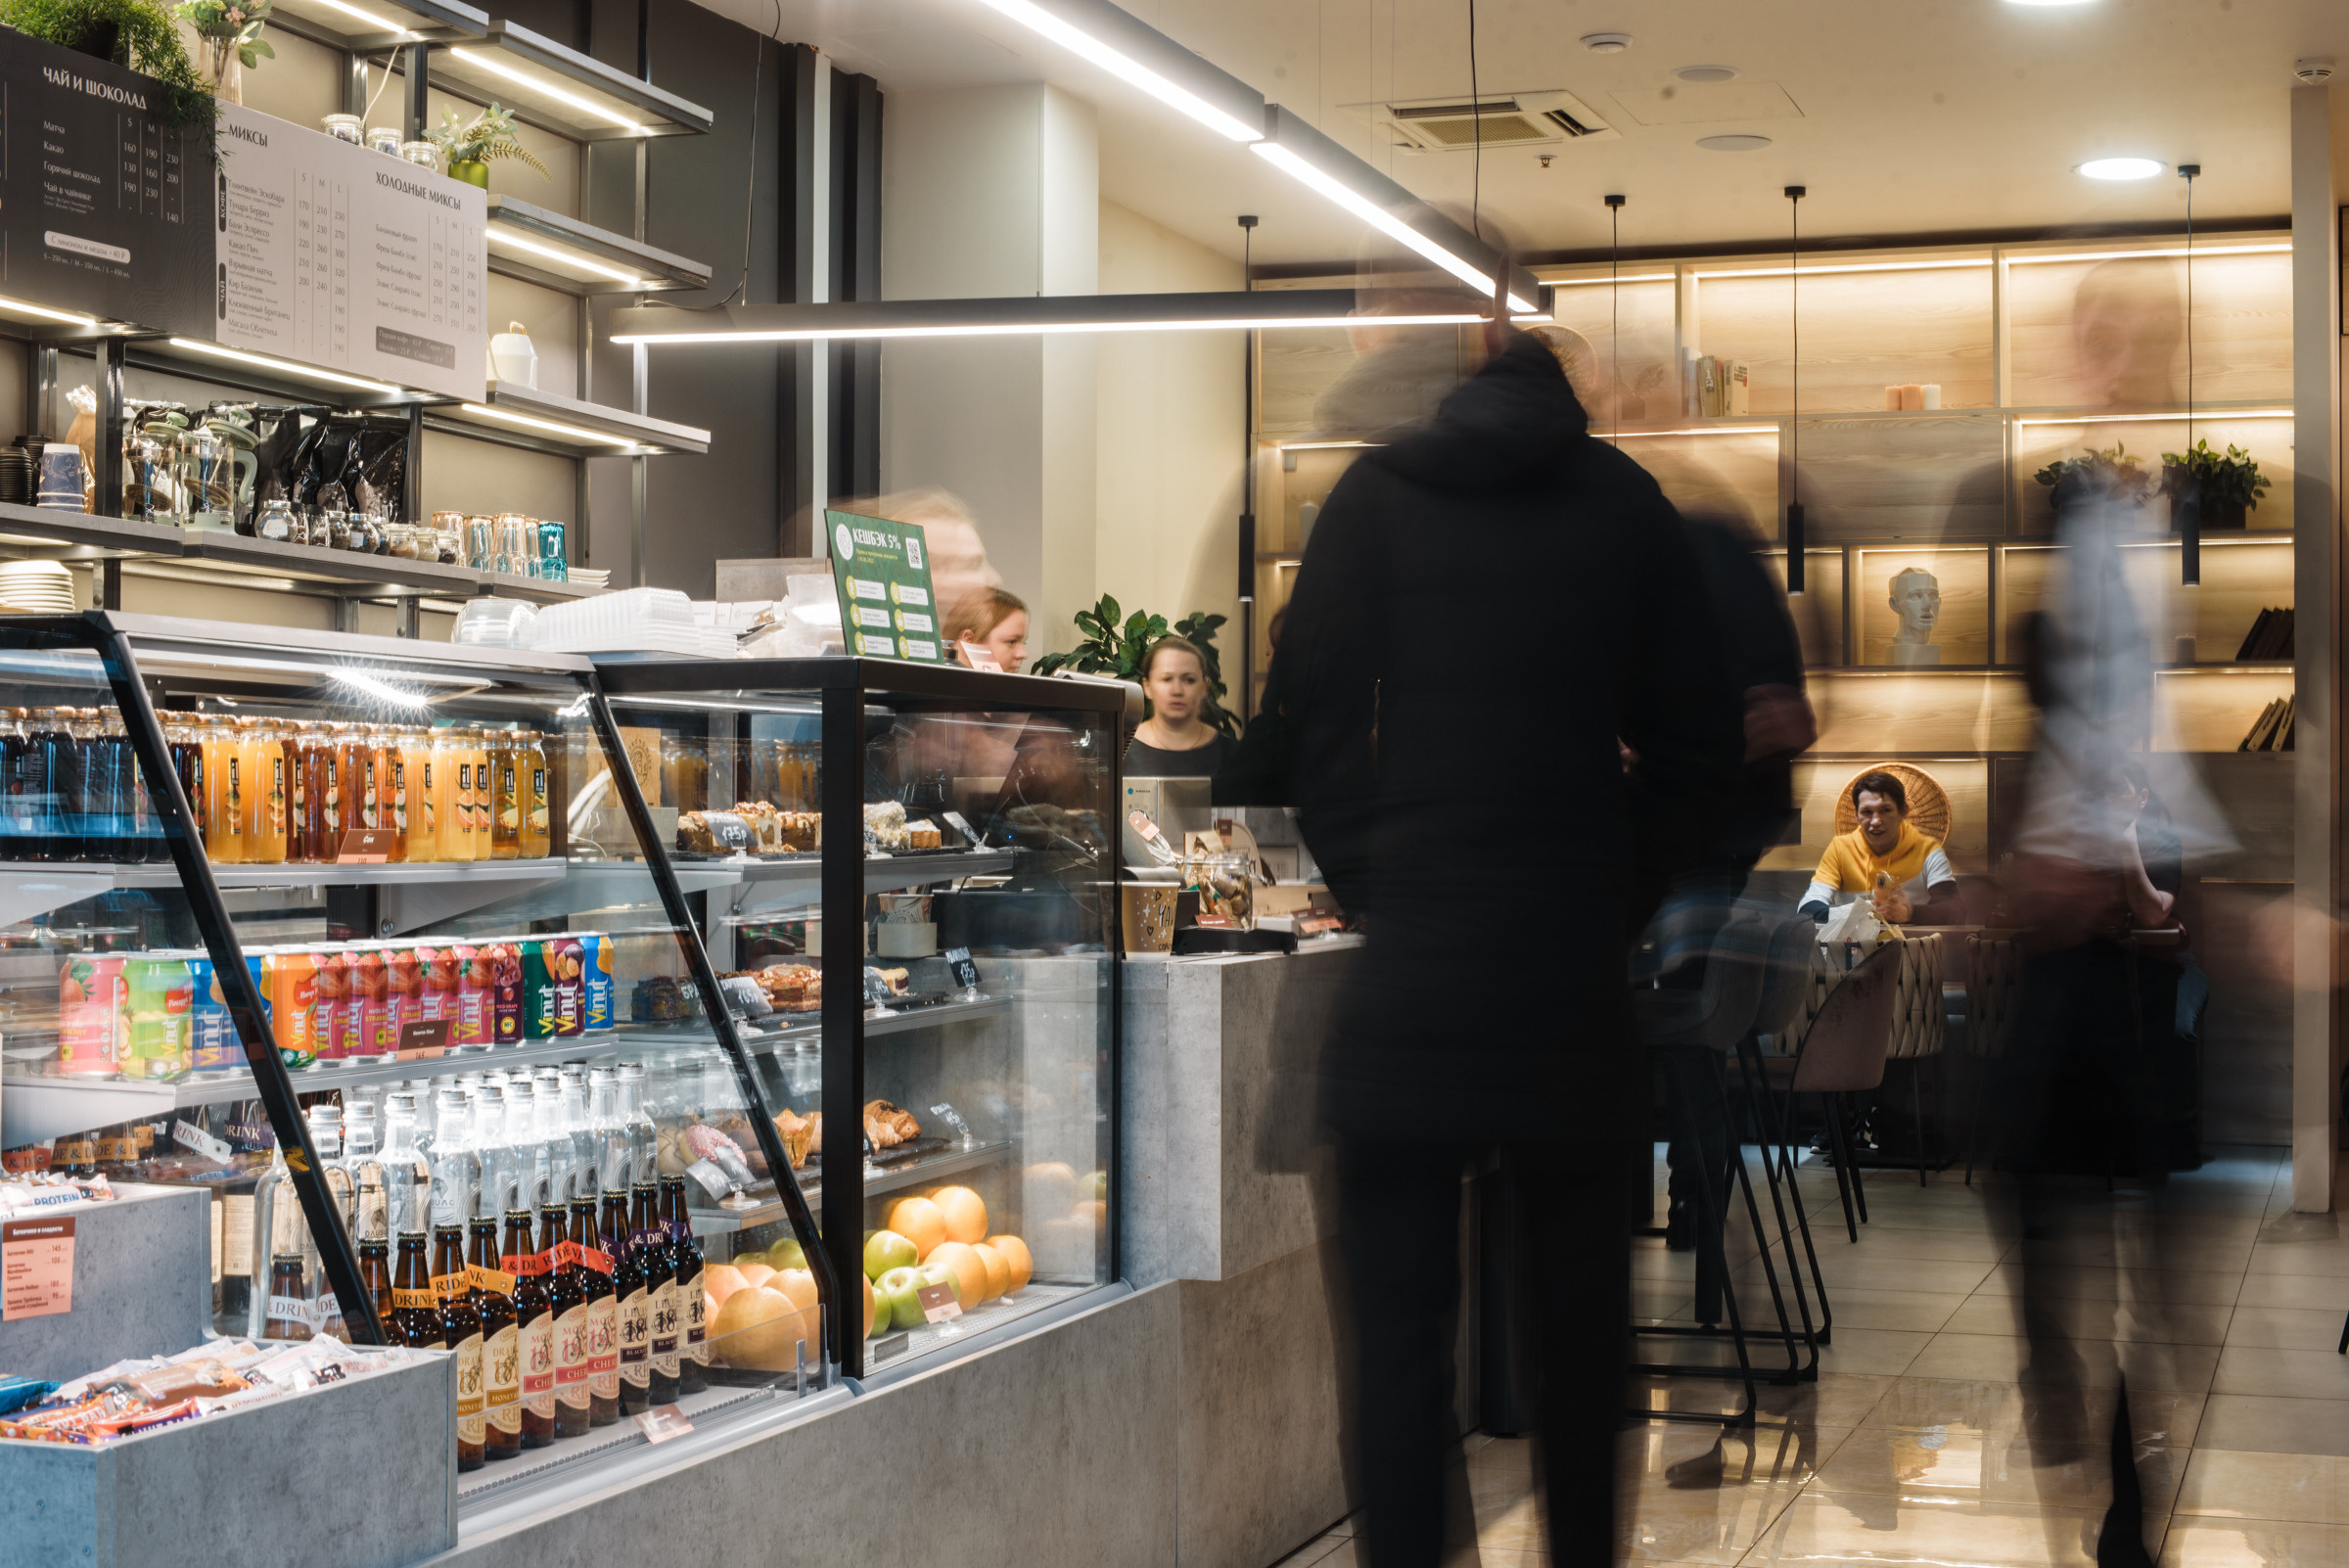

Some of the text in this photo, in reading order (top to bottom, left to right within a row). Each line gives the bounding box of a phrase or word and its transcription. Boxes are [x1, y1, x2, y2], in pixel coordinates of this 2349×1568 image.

[43, 66, 147, 110] ЧАЙ И ШОКОЛАД
[127, 117, 133, 127] S
[43, 120, 179, 164] Матча 160 190 230
[229, 123, 268, 148] МИКСЫ
[43, 140, 179, 184] Какао 130 160 200
[43, 161, 159, 199] Горячий шоколад 190 230
[301, 173, 306, 182] S
[43, 181, 58, 194] Чай
[166, 212, 179, 223] 140
[376, 171, 461, 210] ХОЛОДНЫЕ МИКСЫ
[299, 200, 309, 210] 170
[317, 206, 327, 216] 210
[335, 211, 345, 221] 250
[299, 219, 309, 230] 190
[317, 224, 327, 235] 230
[335, 230, 345, 240] 270
[228, 239, 245, 252] Какао
[299, 258, 309, 268] 210
[299, 238, 309, 249] 220
[299, 276, 309, 287] 200
[317, 281, 327, 292] 240
[852, 528, 901, 550] КЕШБЭК 5%
[538, 984, 554, 1034] Vinut
[555, 982, 577, 1033] Vinut
[587, 978, 608, 1024] Vinut
[459, 990, 483, 1039] Vinut
[161, 1018, 179, 1055] Vinut
[196, 1007, 223, 1066] Vinut
[291, 1010, 306, 1045] Vinut
[174, 1126, 206, 1148] RINK
[34, 1192, 79, 1206] PROTEIN
[634, 1232, 663, 1245] & DRI
[508, 1261, 518, 1270] &
[542, 1244, 572, 1268] RIDE
[436, 1277, 467, 1293] RIDE
[275, 1301, 309, 1318] DRIN
[593, 1360, 616, 1369] CHER
